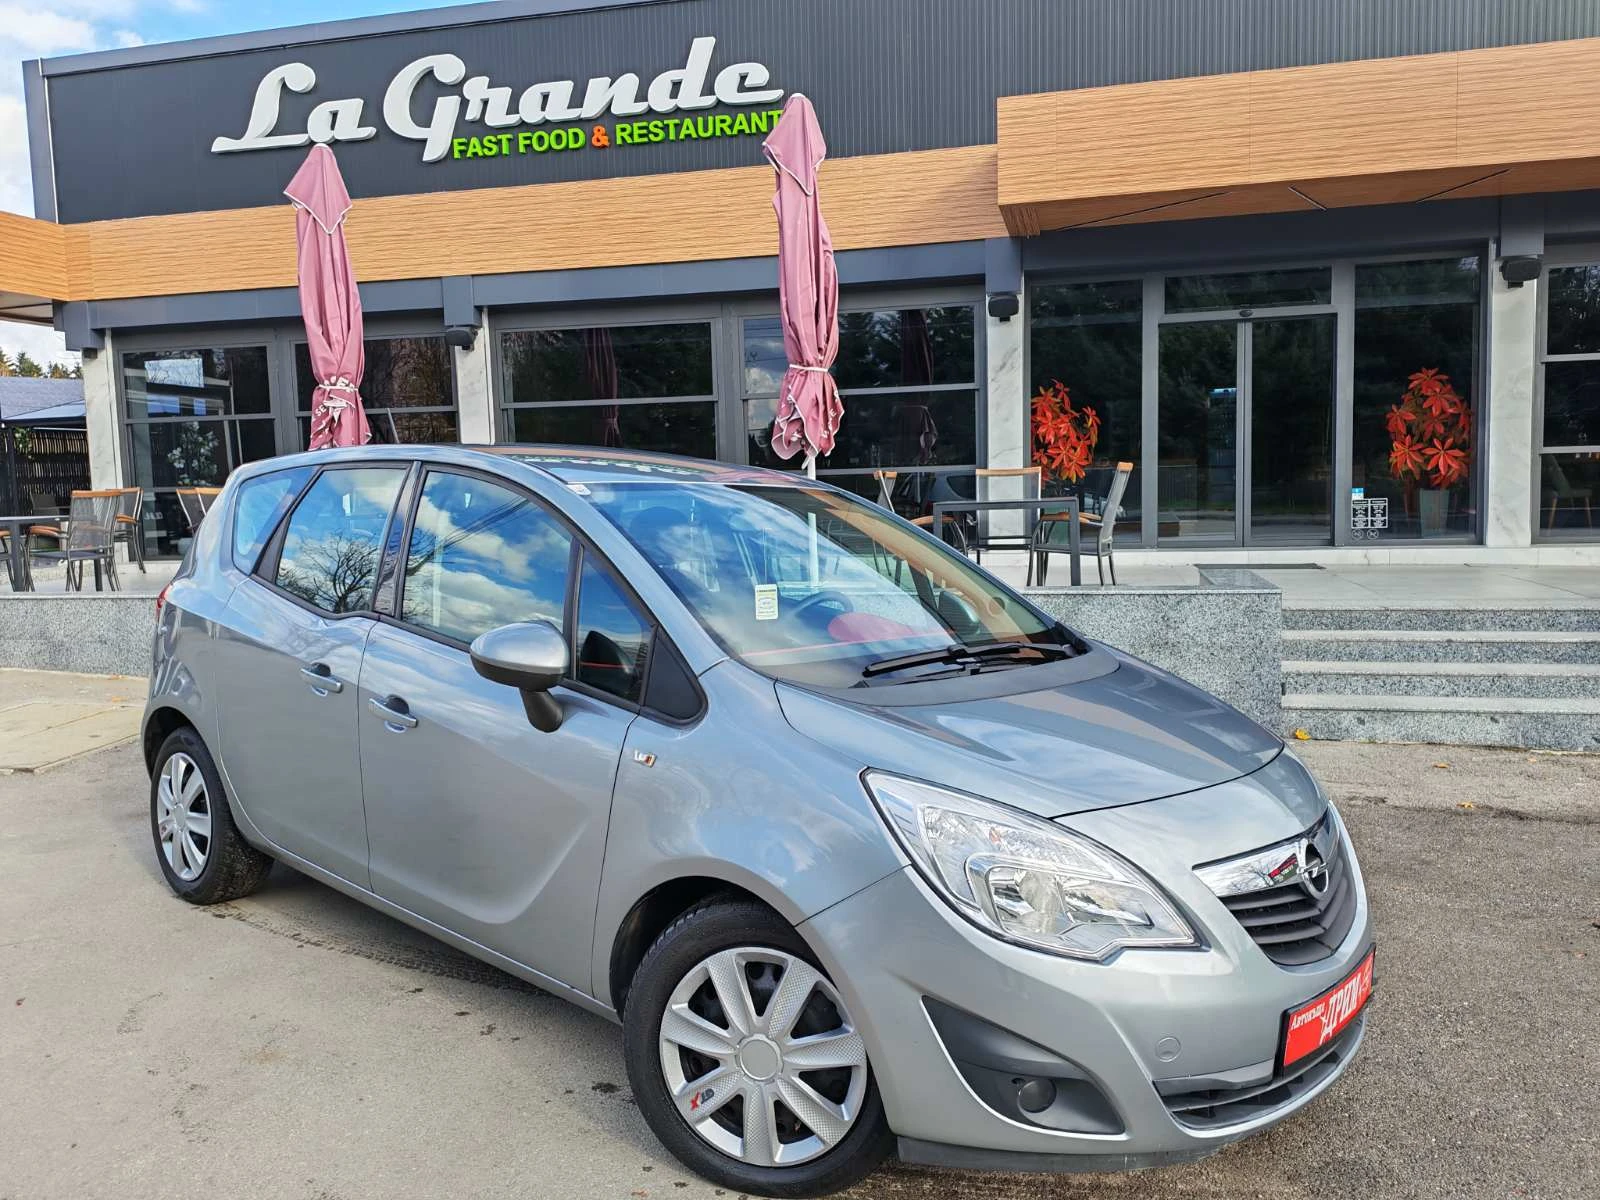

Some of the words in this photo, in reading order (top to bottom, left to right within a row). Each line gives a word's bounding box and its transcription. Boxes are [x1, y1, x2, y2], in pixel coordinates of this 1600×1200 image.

[211, 62, 377, 153] La
[383, 36, 784, 162] Grande
[453, 134, 513, 159] FAST
[518, 127, 586, 154] FOOD
[591, 124, 610, 148] &
[615, 109, 784, 145] RESTAURANT
